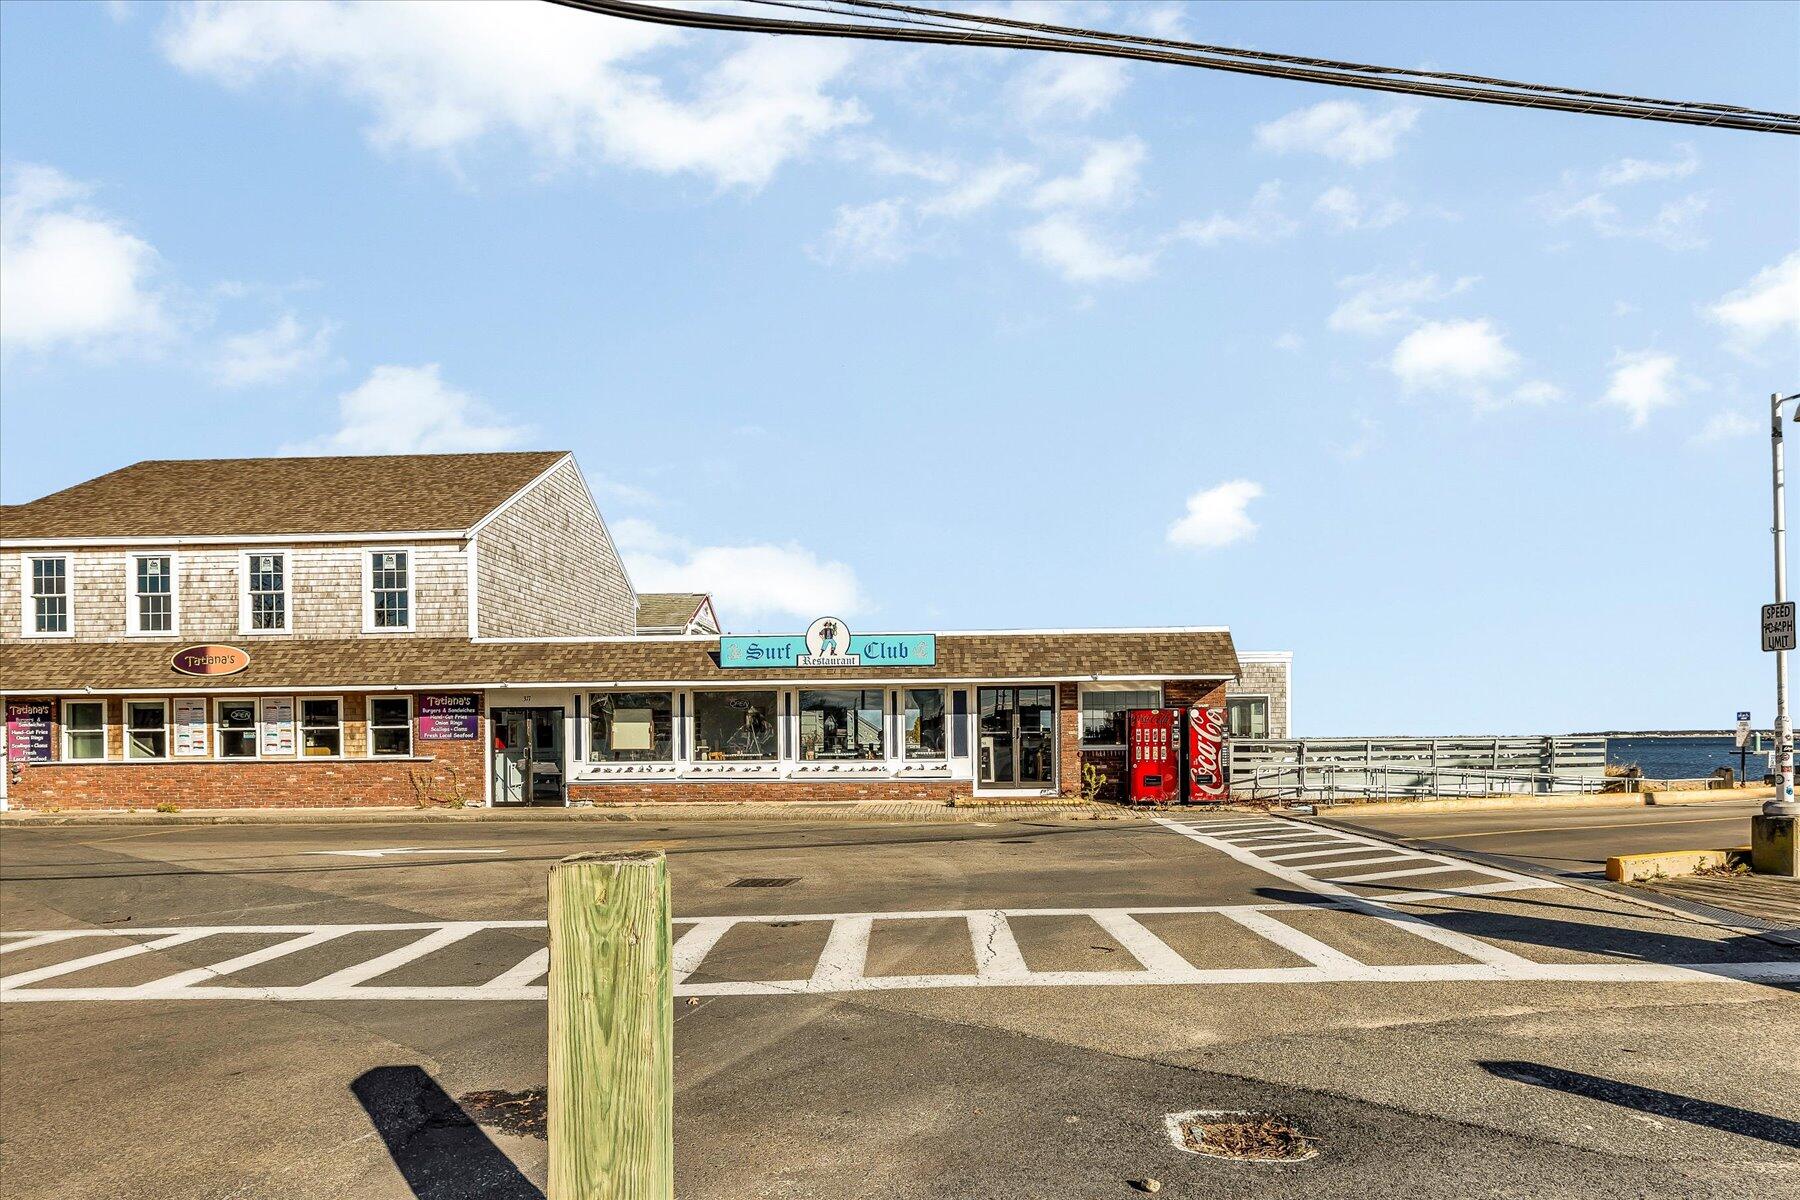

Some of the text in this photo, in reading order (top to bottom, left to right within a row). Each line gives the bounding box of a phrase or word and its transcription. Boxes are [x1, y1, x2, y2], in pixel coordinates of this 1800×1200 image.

[1767, 605, 1790, 619] SPEED
[1775, 620, 1793, 632] MPH
[1769, 635, 1788, 648] LIMIT
[746, 641, 909, 660] Surf Club
[184, 654, 236, 667] Tatiana's
[802, 656, 856, 666] Restaurant
[427, 696, 471, 706] Tatiana's
[10, 705, 50, 715] Tatiana's
[232, 711, 250, 719] OPEN
